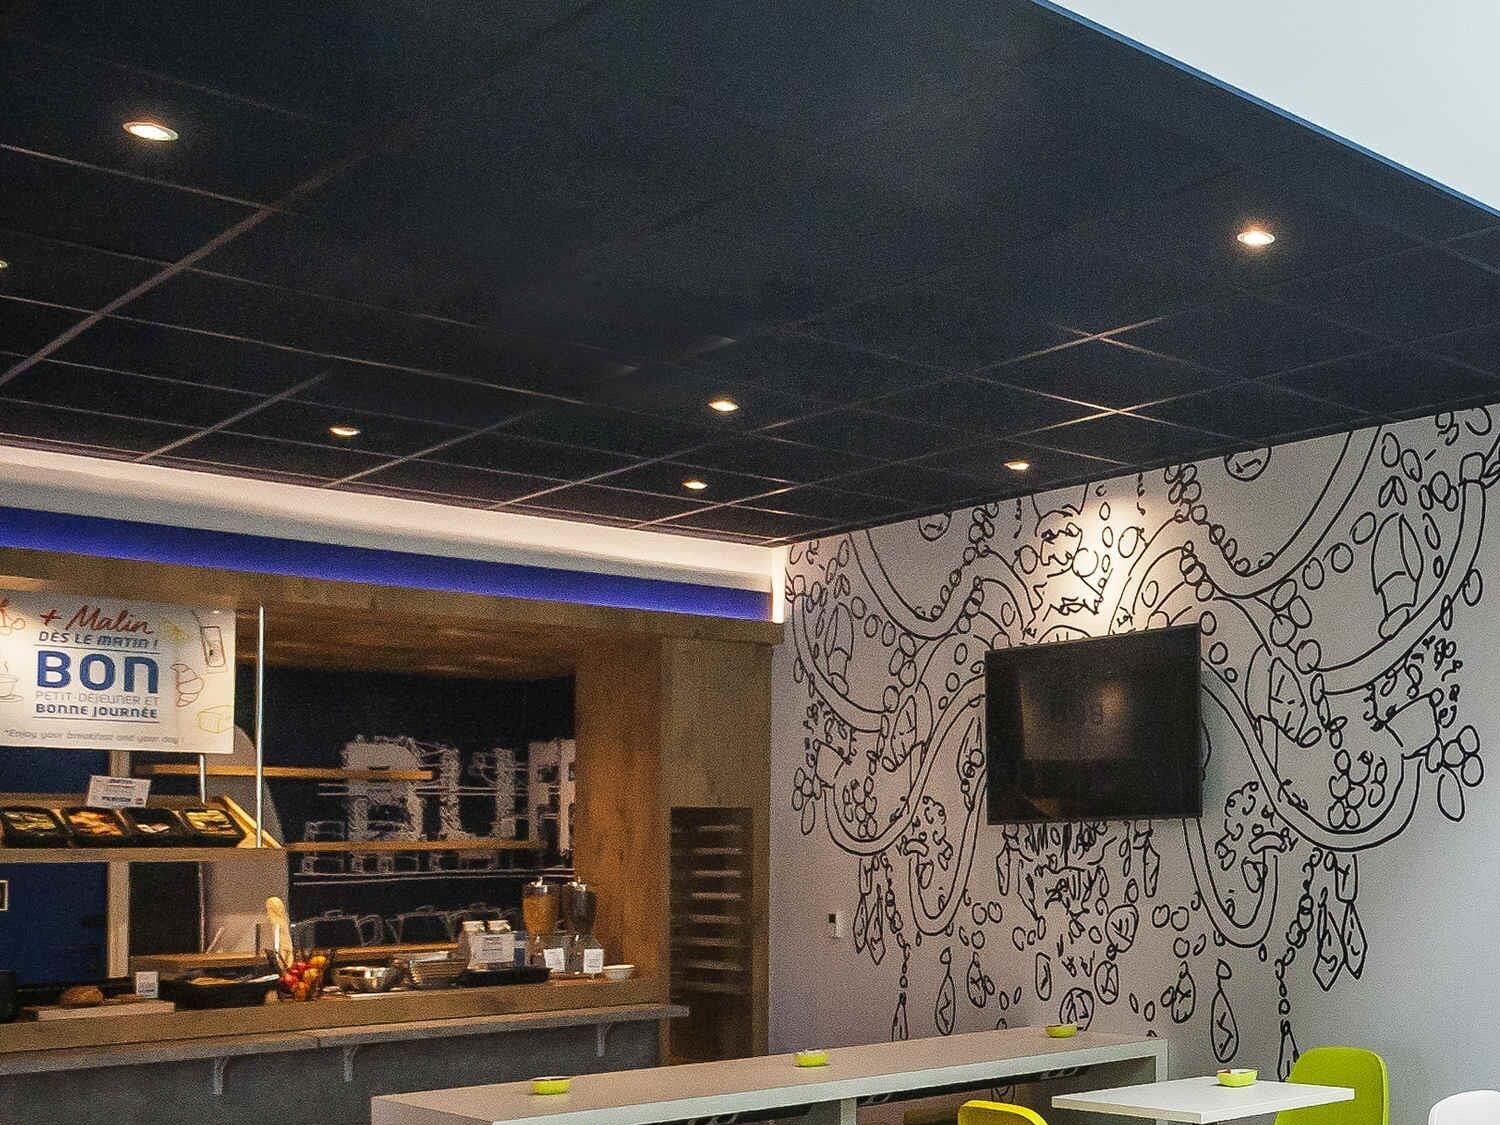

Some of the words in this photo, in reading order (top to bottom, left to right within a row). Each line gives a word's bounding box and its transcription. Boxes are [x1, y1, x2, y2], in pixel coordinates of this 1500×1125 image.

[65, 604, 155, 635] Malin
[74, 631, 94, 646] LE
[97, 635, 150, 648] MATIN
[36, 650, 160, 695] BON
[35, 703, 90, 716] BONNE
